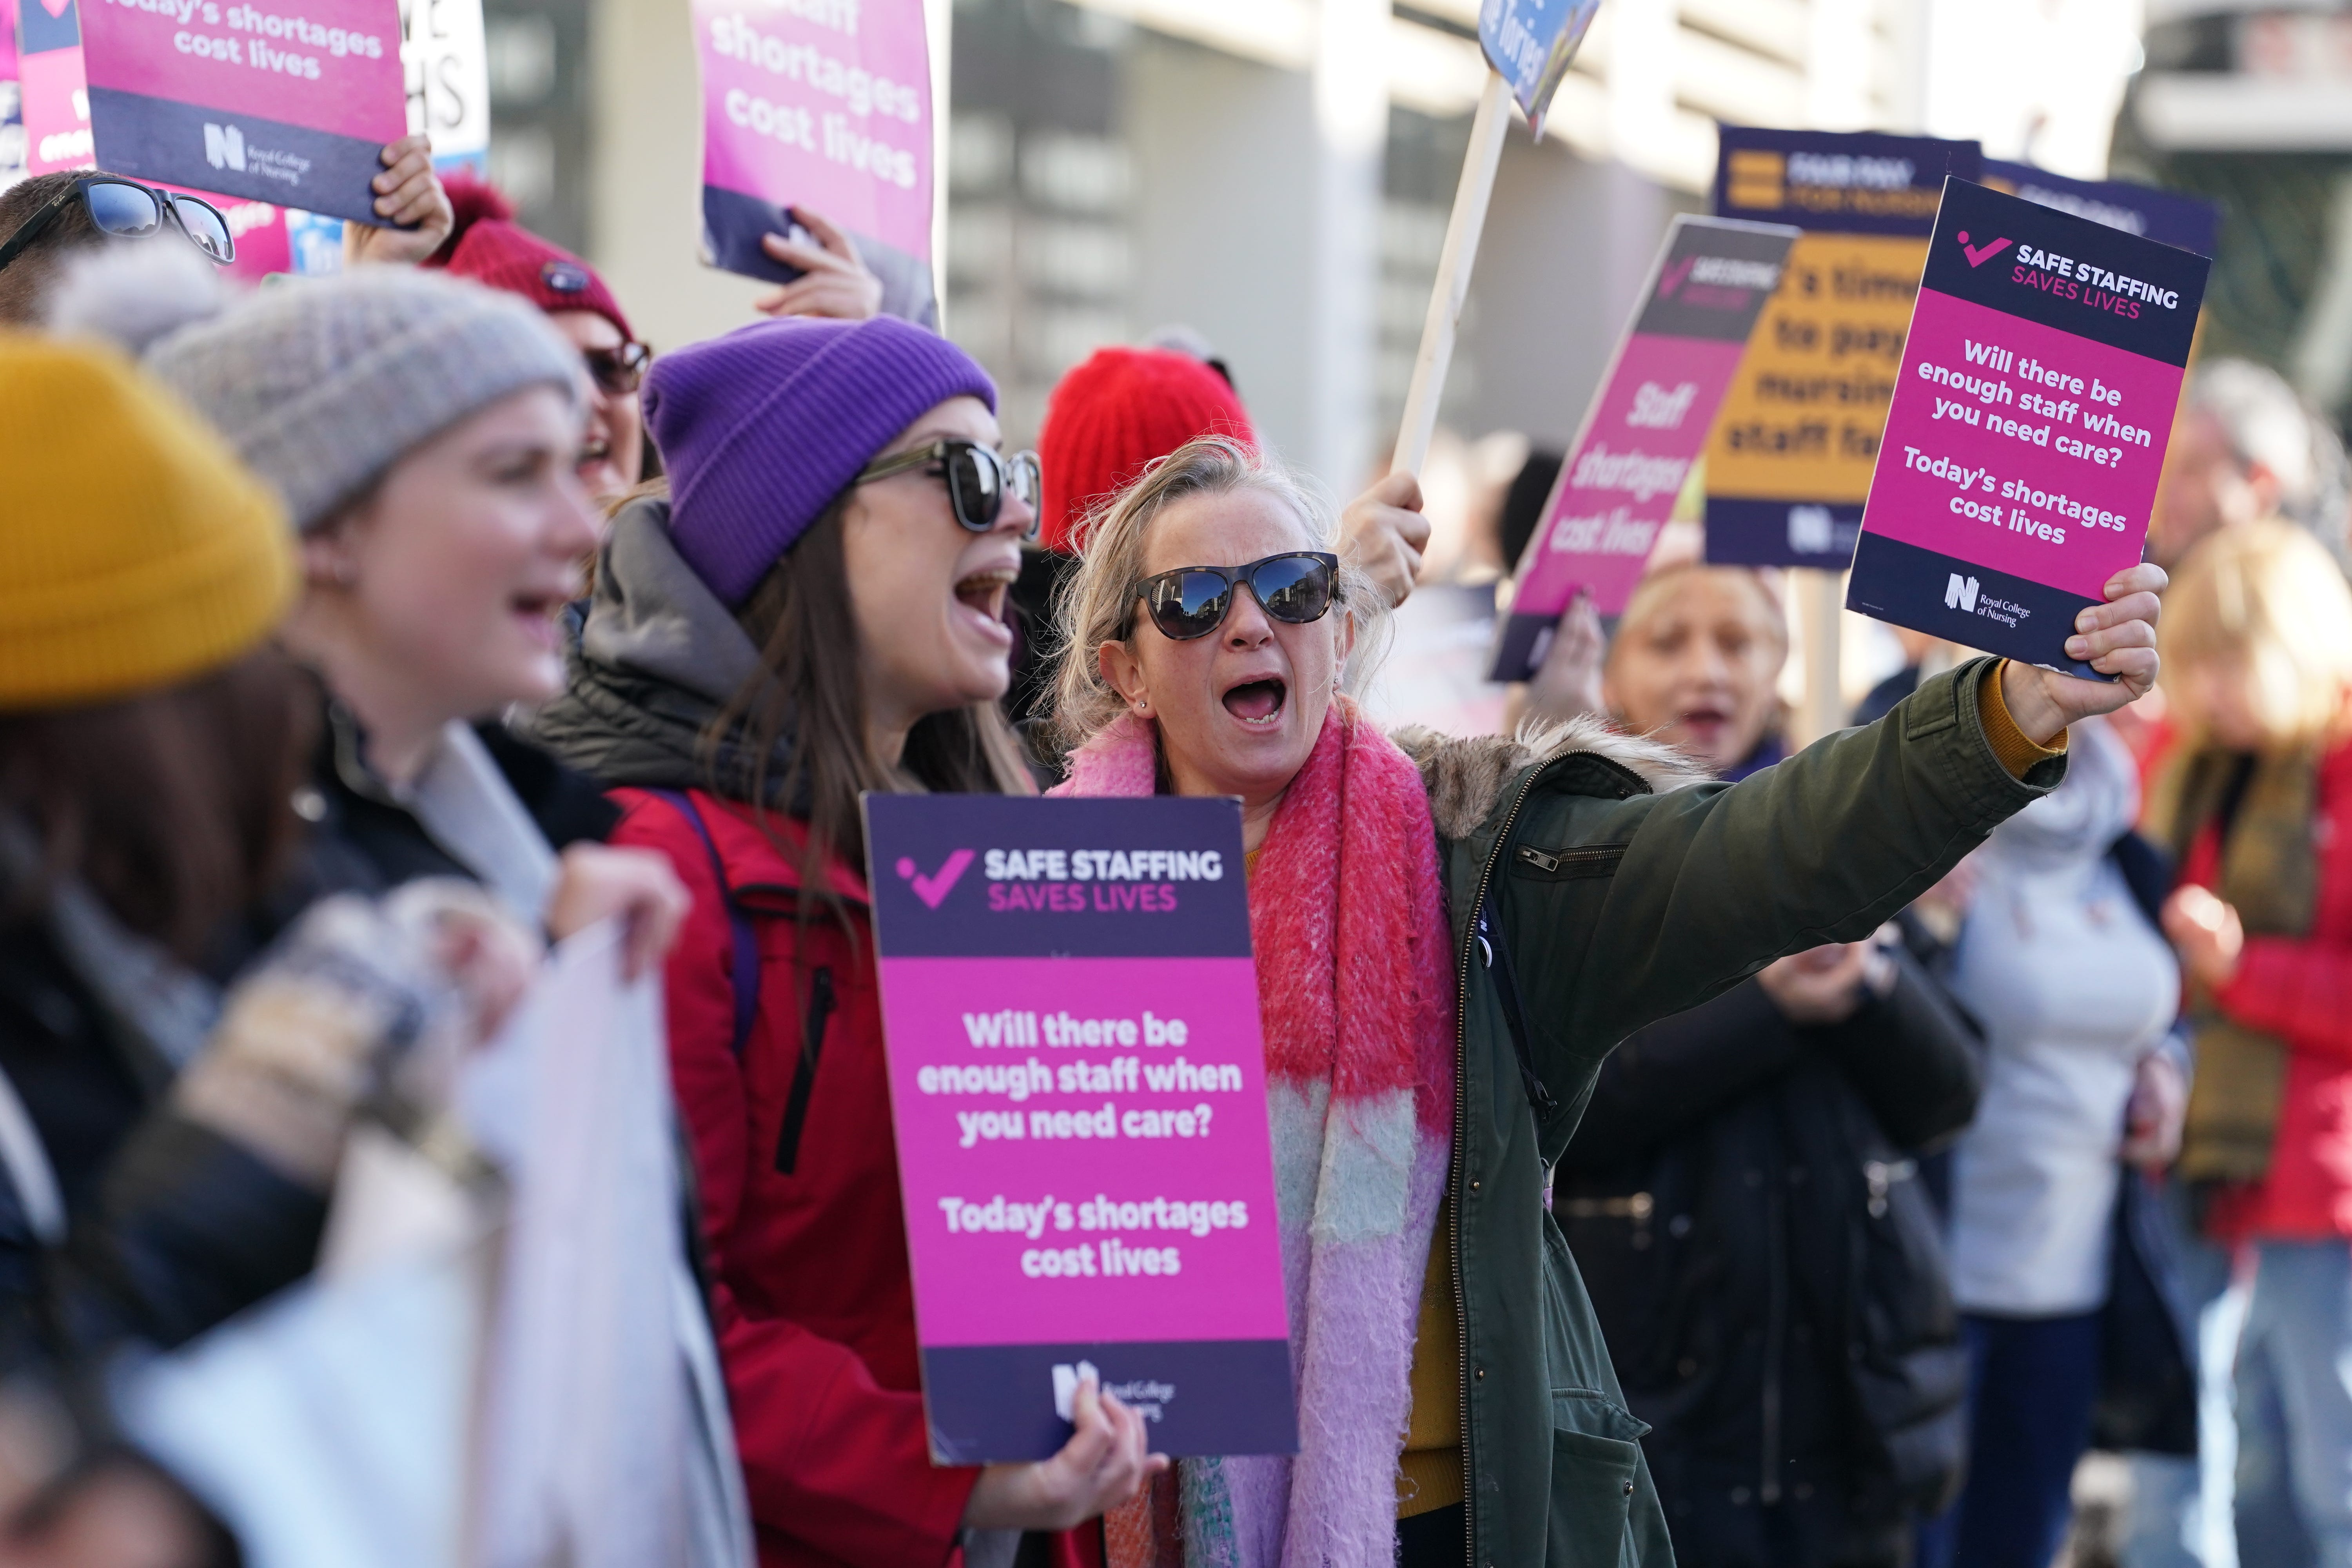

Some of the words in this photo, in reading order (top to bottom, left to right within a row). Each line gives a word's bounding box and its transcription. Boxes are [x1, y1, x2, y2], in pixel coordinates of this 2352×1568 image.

[174, 30, 242, 64] cost
[247, 38, 321, 80] lives
[226, 3, 383, 59] shortages
[709, 11, 921, 124] shortages
[724, 87, 816, 153] cost
[823, 111, 918, 190] lives
[2011, 265, 2078, 299] SAVES
[2083, 286, 2141, 319] LIVES
[2016, 245, 2074, 277] SAFE
[2075, 263, 2179, 309] STAFFING
[1965, 339, 2013, 373] Will
[2018, 358, 2084, 395] there
[2090, 378, 2122, 407] be
[1918, 362, 2013, 405] enough
[2018, 393, 2080, 424] staff
[2083, 412, 2151, 447] when
[1931, 397, 1981, 426] you
[1986, 414, 2051, 447] need
[2055, 436, 2123, 468] care?
[1904, 445, 1996, 492] Today's
[2001, 479, 2127, 532] shortages
[1949, 497, 2003, 526] cost
[2008, 508, 2066, 544] lives
[1977, 607, 1987, 616] of
[1987, 608, 2017, 628] Nursing
[1980, 594, 2002, 609] Royal
[2002, 601, 2031, 619] College
[984, 849, 1069, 880] SAFE
[1071, 849, 1223, 881] STAFFING
[988, 884, 1086, 912] SAVES
[1093, 884, 1176, 912] LIVES
[962, 1009, 1039, 1048] Will
[1042, 1011, 1139, 1048] there
[1142, 1011, 1188, 1047] be
[917, 1057, 1054, 1102] enough
[1057, 1056, 1140, 1093] staff
[1143, 1056, 1243, 1092] when
[956, 1111, 1025, 1149] you
[1029, 1102, 1117, 1139] need
[1122, 1103, 1213, 1138] care?
[938, 1195, 1074, 1240] Today's
[1078, 1194, 1249, 1237] shortages
[1021, 1243, 1097, 1278] cost
[1100, 1238, 1181, 1276] lives
